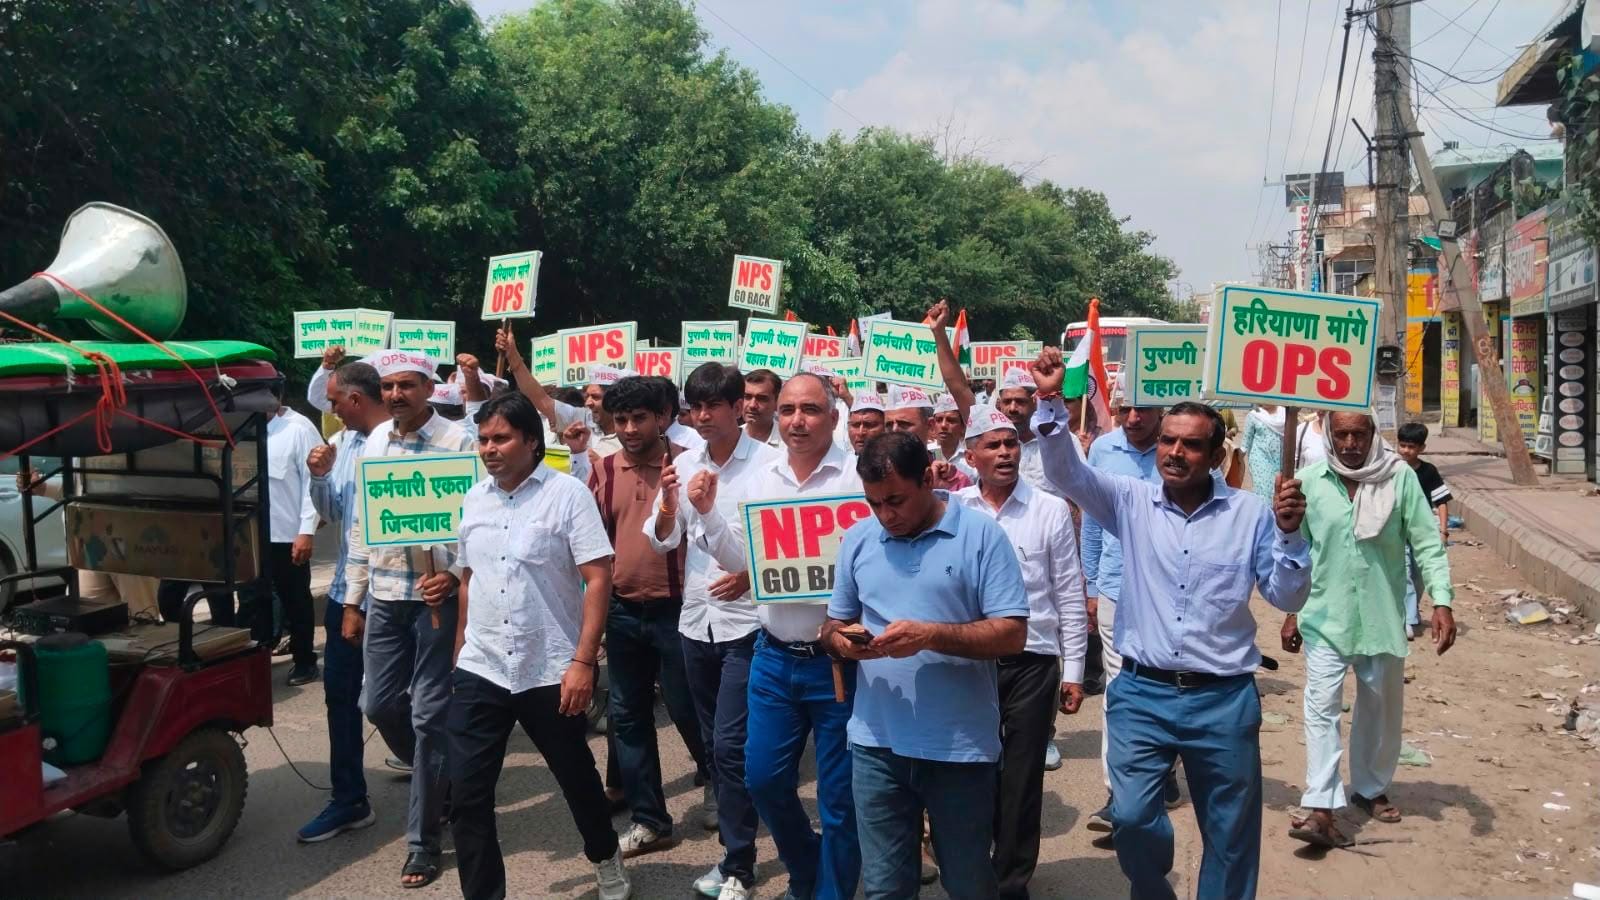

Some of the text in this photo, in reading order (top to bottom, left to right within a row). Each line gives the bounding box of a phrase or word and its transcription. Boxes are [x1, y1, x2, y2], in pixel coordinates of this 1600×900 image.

[492, 263, 517, 285] हरियाणा
[738, 260, 773, 291] NPS
[492, 282, 524, 313] OPS
[734, 289, 771, 308] GO BACK
[1232, 297, 1369, 346] हरियाणा मांगे
[568, 329, 624, 365] NPS
[687, 328, 710, 344] पुराणी
[749, 328, 799, 348] पुराणी पेंशन
[872, 330, 913, 351] कर्मचारी
[687, 347, 708, 357] बहाल
[710, 345, 725, 357] करो
[803, 337, 840, 358] NPS
[975, 345, 1017, 365] UPS
[1142, 341, 1198, 372] पुराणी
[381, 353, 408, 366] OPS
[635, 351, 672, 377] NPS
[745, 352, 769, 366] बहाल
[769, 353, 787, 369] करो
[876, 354, 926, 378] जिन्दाबाद
[1241, 339, 1352, 400] OPS
[566, 366, 586, 383] GO
[973, 366, 988, 377] GO
[1142, 379, 1192, 397] बहाल
[367, 470, 473, 500] कर्मचारी एकता
[379, 508, 452, 535] जिन्दाबाद
[759, 501, 872, 561] NPS
[762, 566, 800, 594] GO
